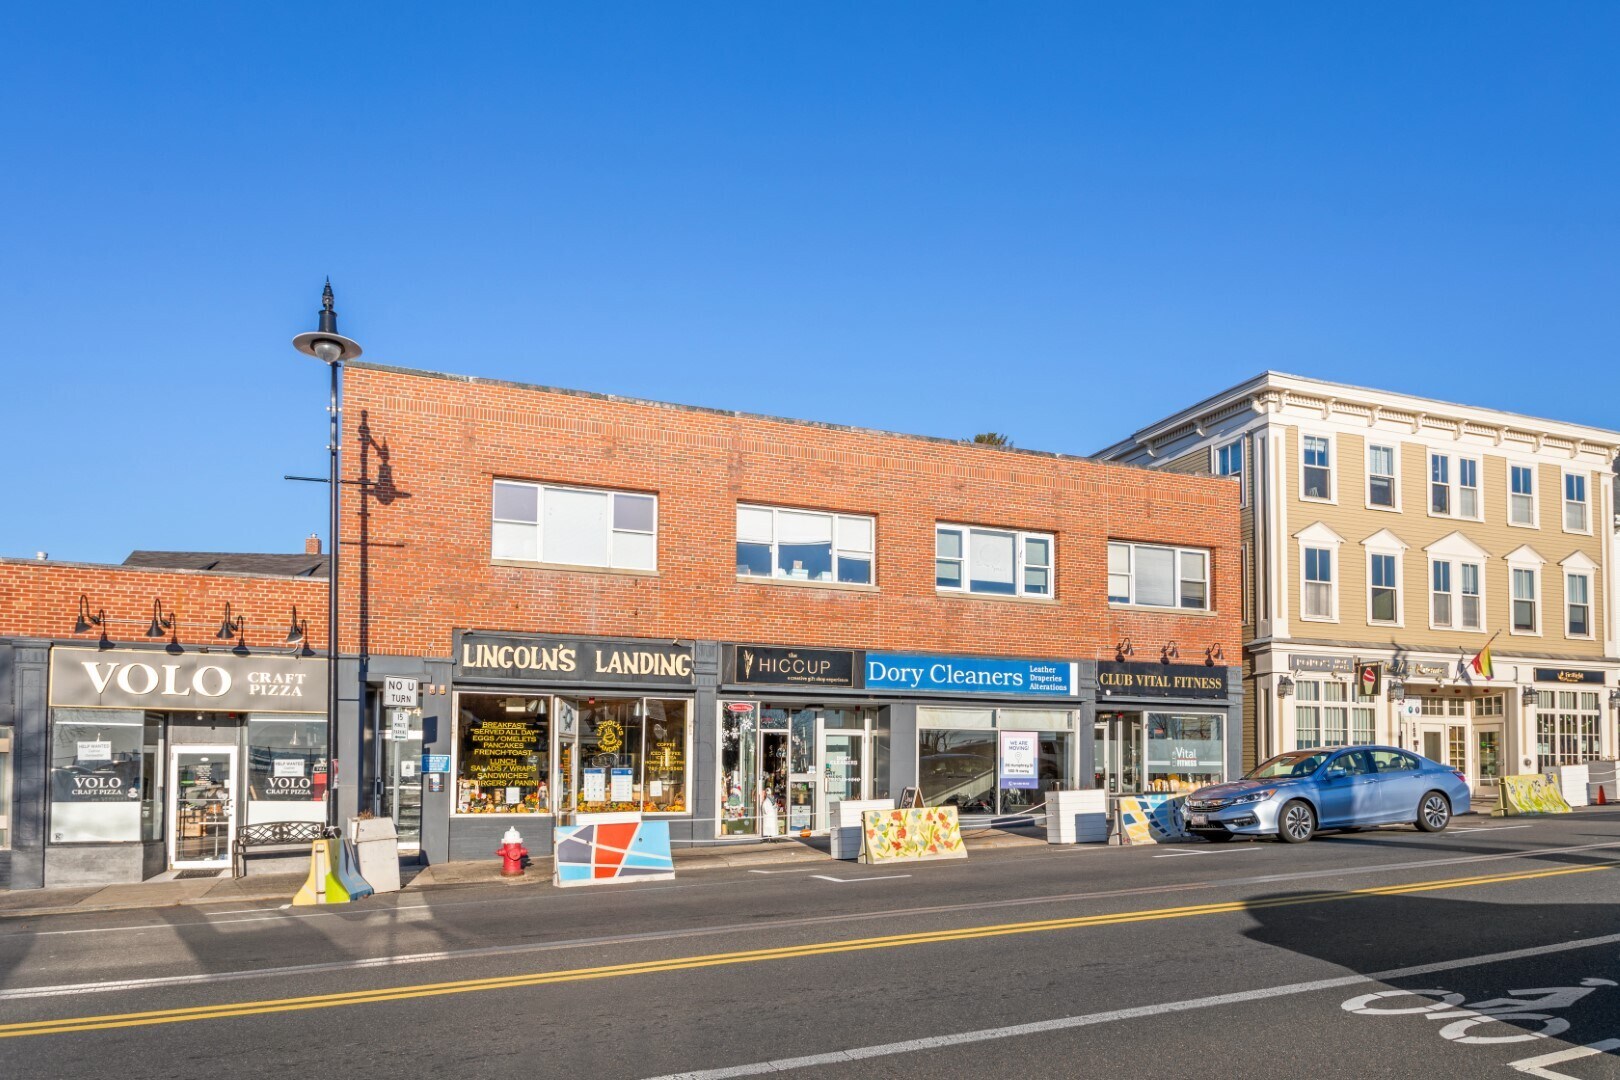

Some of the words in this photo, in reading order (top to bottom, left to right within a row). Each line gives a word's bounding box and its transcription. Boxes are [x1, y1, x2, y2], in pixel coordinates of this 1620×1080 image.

[462, 643, 576, 672] LINCOLN'S
[595, 650, 691, 677] LANDING
[759, 657, 831, 675] HICCUP
[868, 661, 924, 687] Dory
[930, 664, 1023, 686] Cleaners
[1029, 665, 1056, 674] Leather
[81, 661, 232, 697] VOLO
[247, 671, 307, 685] CRAFT
[1029, 674, 1062, 683] Draperies
[1100, 672, 1133, 686] CLUB
[1136, 674, 1171, 688] VITAL
[1174, 676, 1222, 689] FITNESS
[248, 684, 303, 697] PIZZA
[388, 681, 403, 691] NO
[408, 682, 415, 692] U
[1029, 682, 1067, 691] Alterations
[391, 694, 412, 703] TURN
[397, 713, 404, 721] 15
[482, 721, 527, 730] BREAKFAST
[1175, 746, 1197, 759] Vital
[73, 777, 122, 789] VOLO
[267, 777, 311, 789] VOLO
